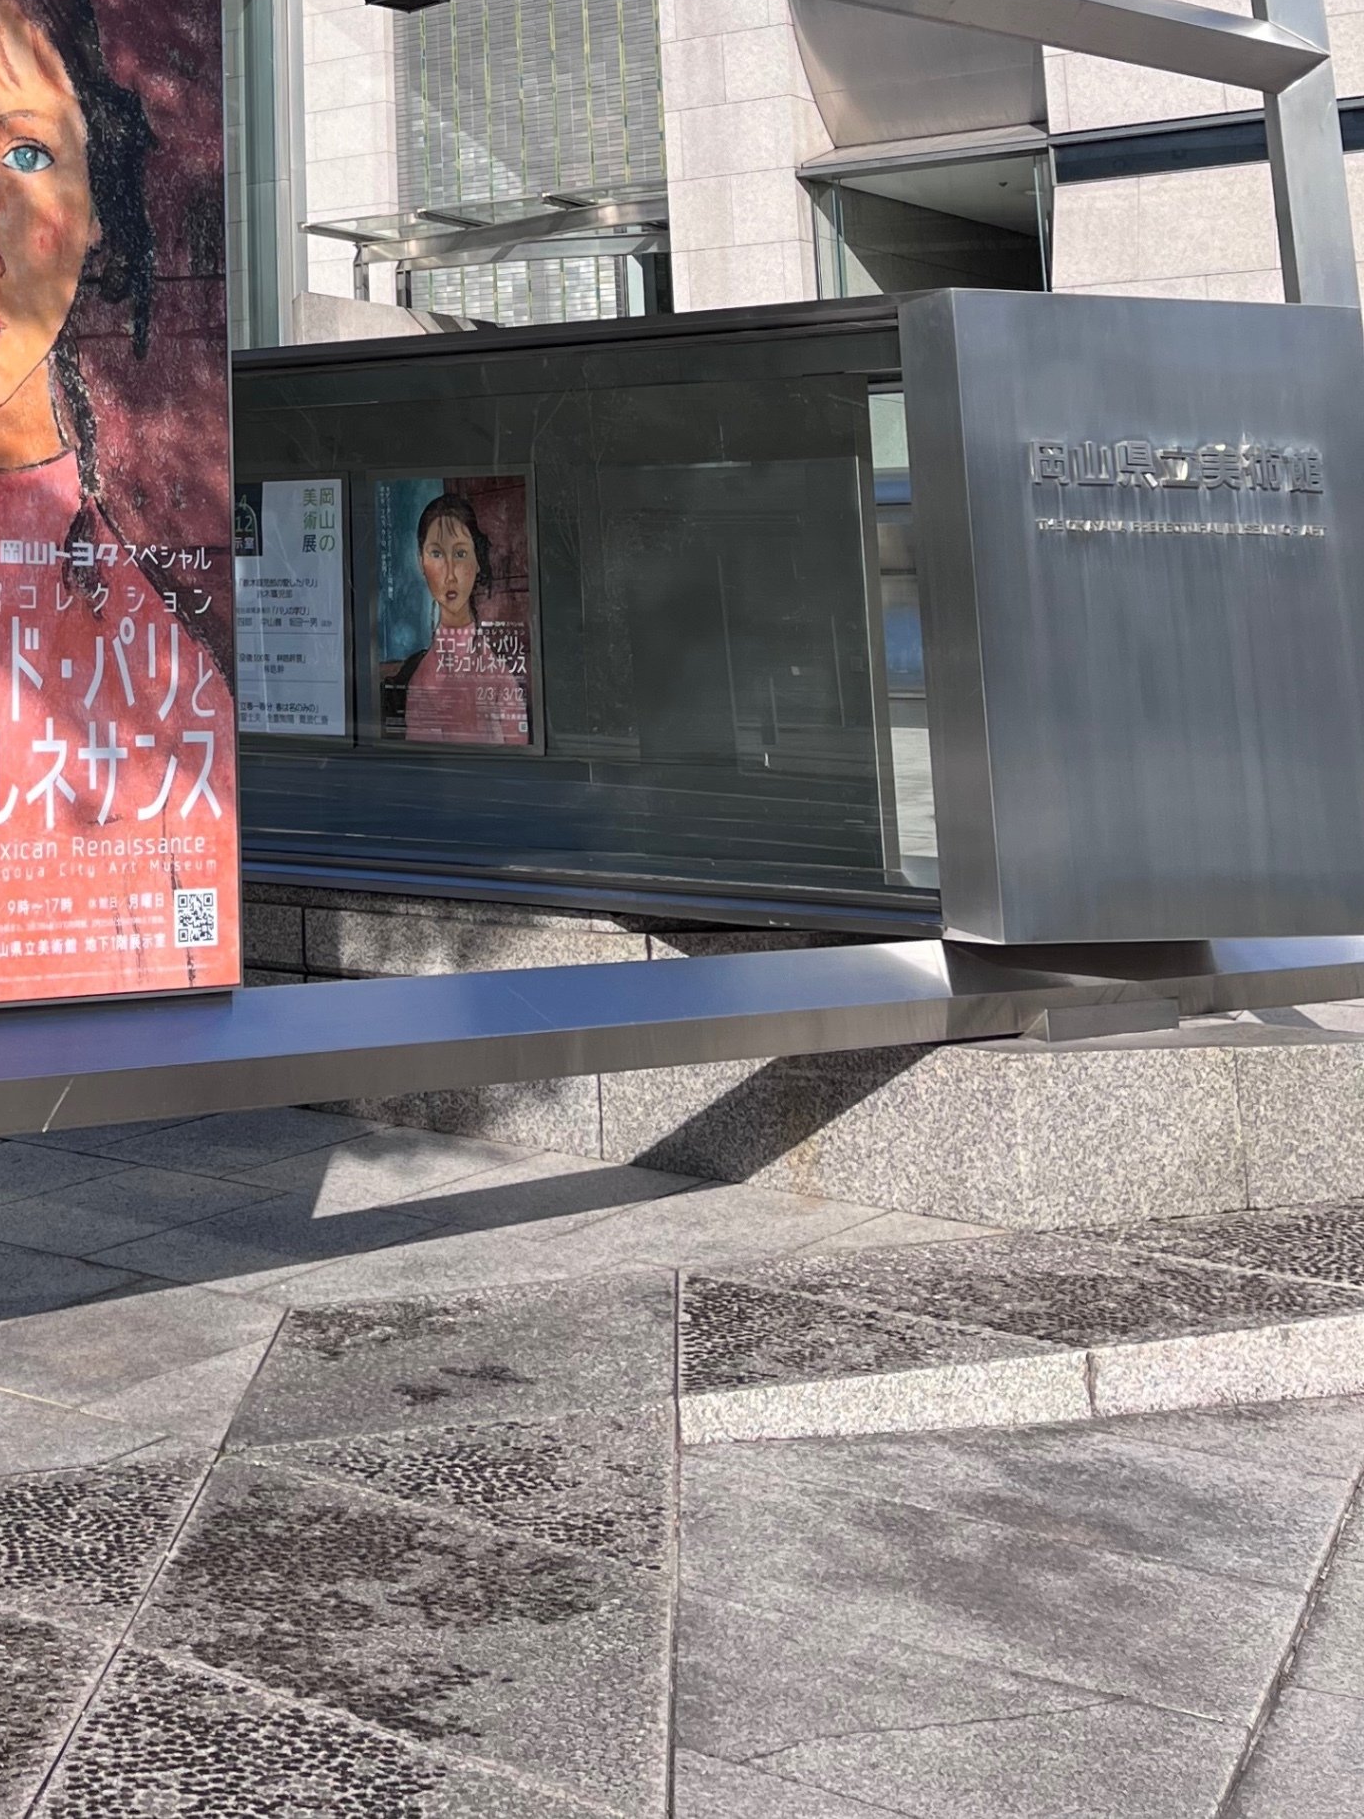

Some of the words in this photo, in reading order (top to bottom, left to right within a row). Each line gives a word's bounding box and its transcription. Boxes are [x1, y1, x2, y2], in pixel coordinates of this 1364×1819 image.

[1031, 439, 1324, 495] 岡山県立美術館
[301, 487, 317, 553] 美術展
[318, 487, 335, 552] 岡山の
[435, 653, 528, 674] メキシコ・ルネサンス
[71, 835, 206, 858] Renaissance
[59, 861, 96, 878] City
[108, 859, 137, 874] Art
[149, 857, 218, 873] Museum
